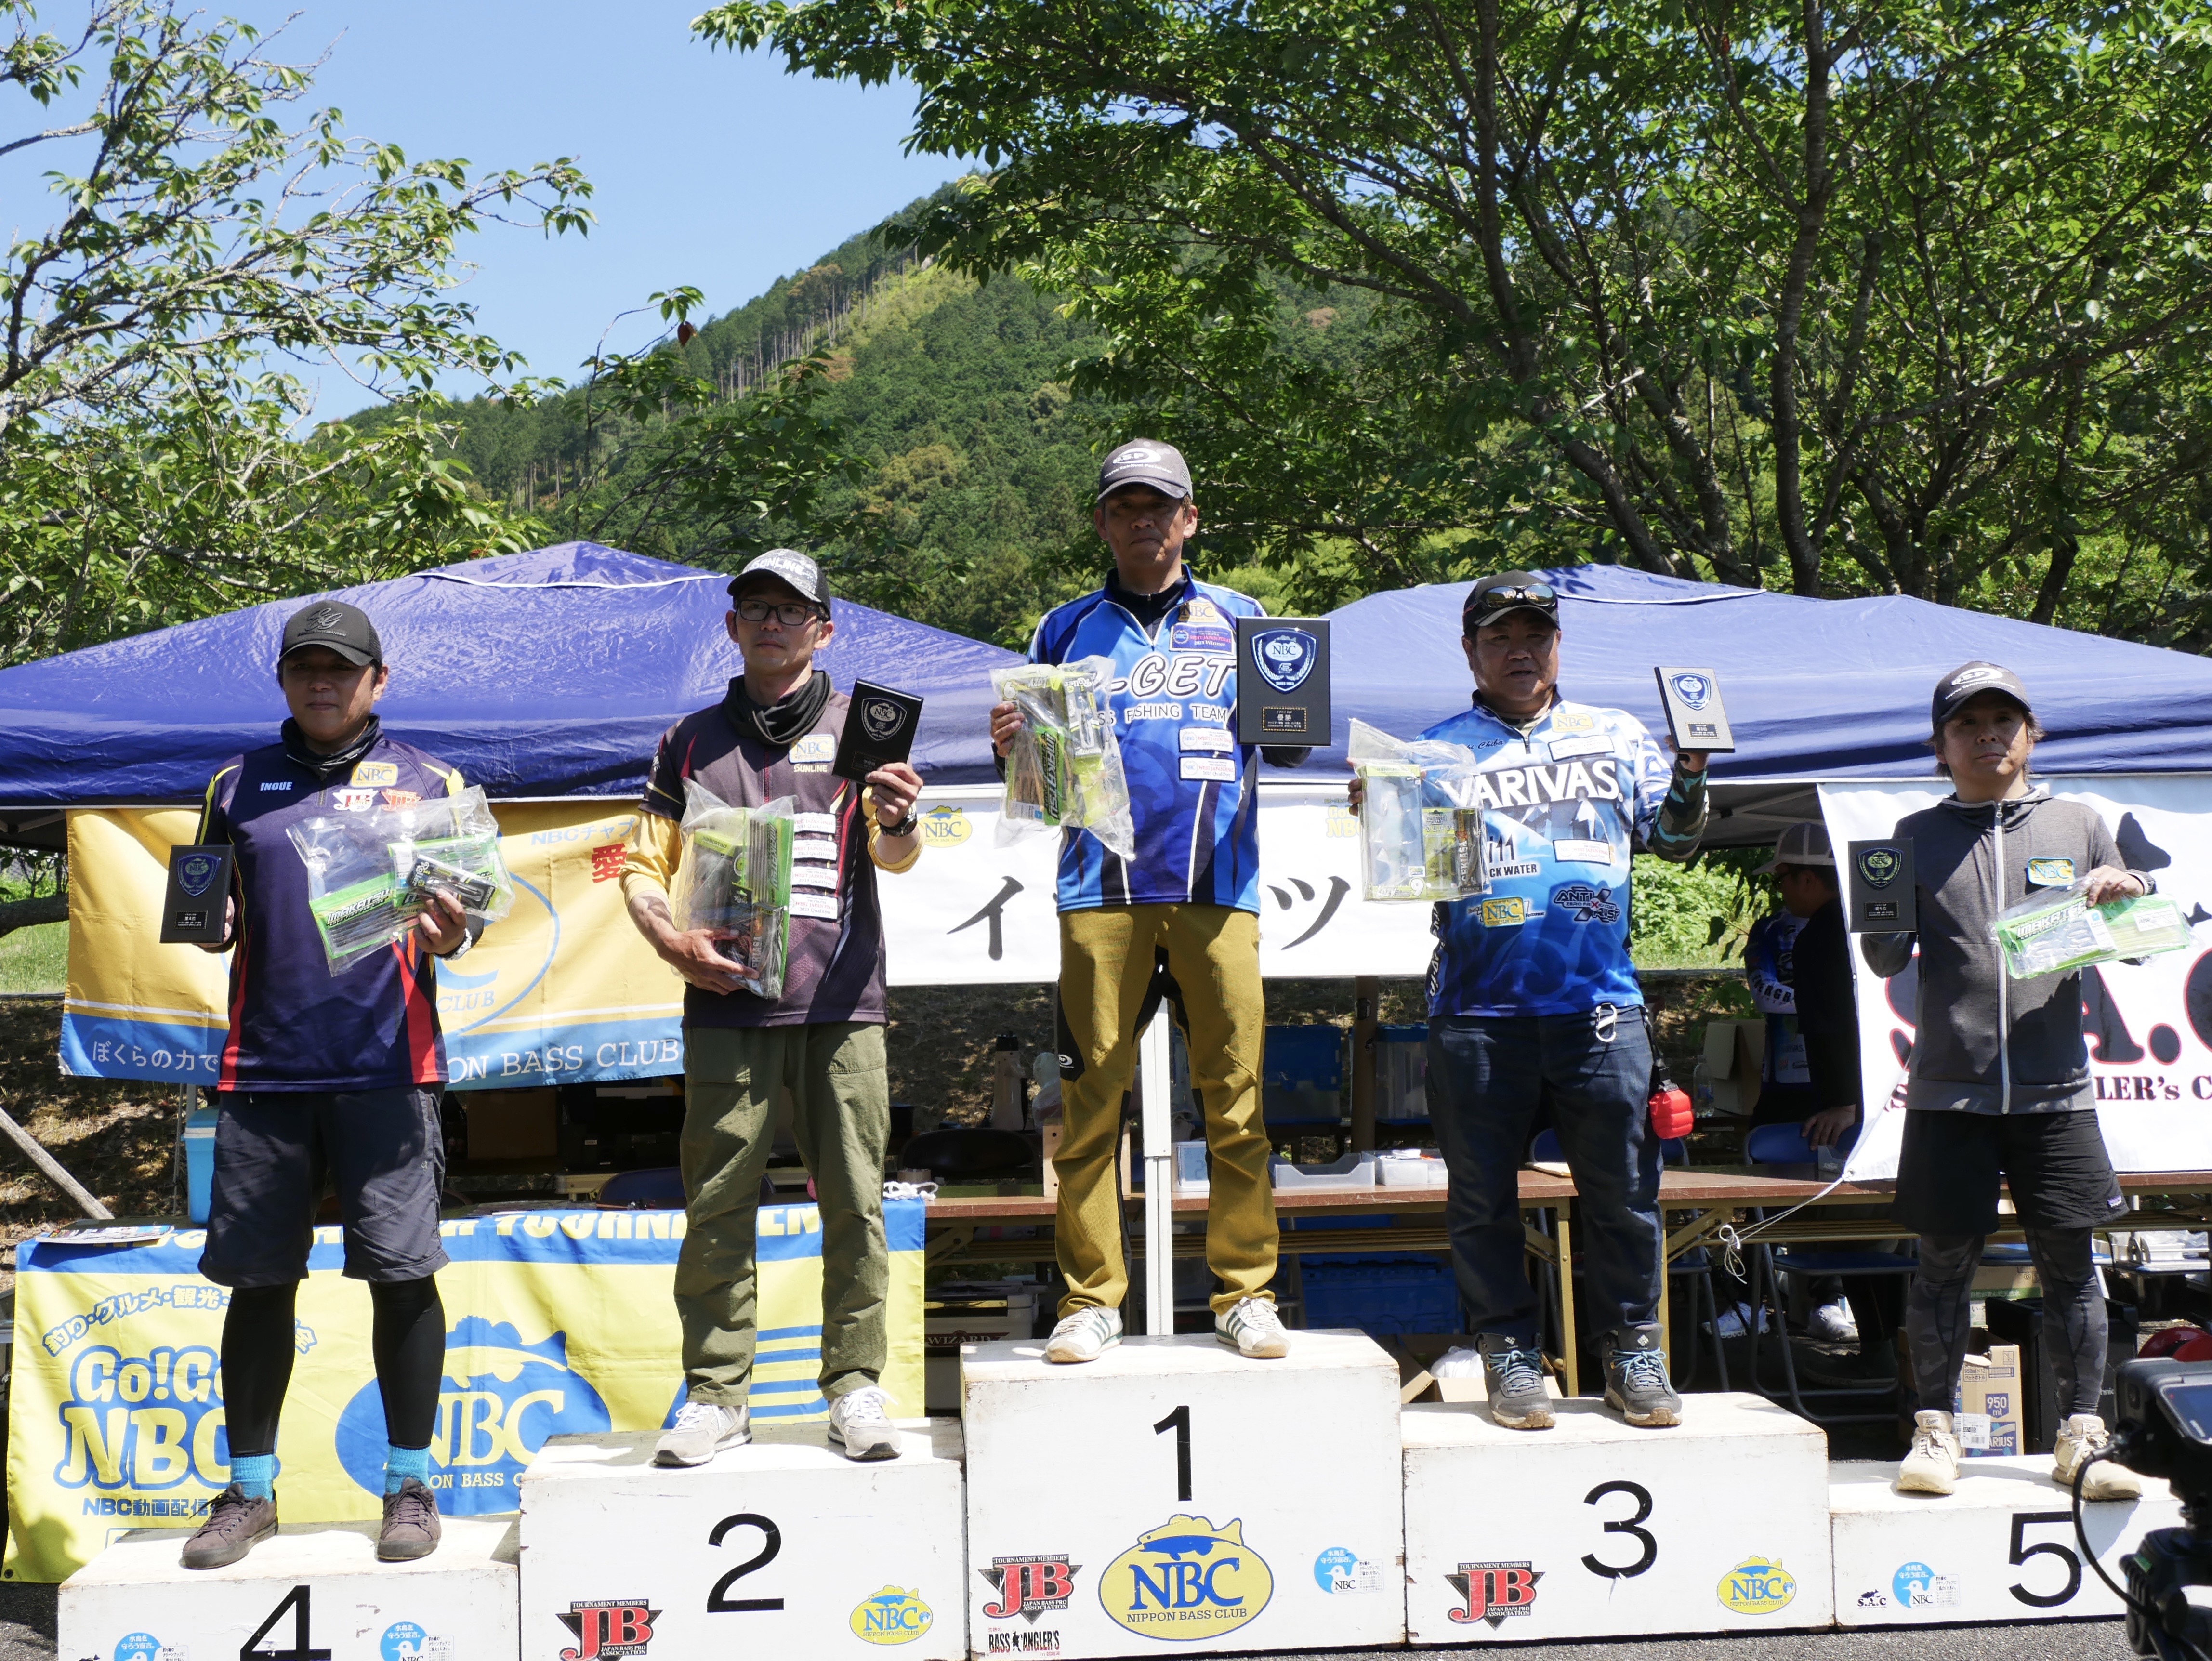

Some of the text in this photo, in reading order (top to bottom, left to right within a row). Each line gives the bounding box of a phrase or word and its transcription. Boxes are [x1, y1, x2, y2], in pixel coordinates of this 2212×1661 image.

[1181, 606, 1215, 618] NBC
[1272, 645, 1297, 656] NBC
[874, 708, 892, 719] NBC
[1126, 704, 1228, 723] FISHING TEAM
[1556, 716, 1590, 728] NBC
[795, 739, 830, 755] NBC
[1477, 738, 1505, 750] Chiba
[356, 766, 393, 782] NBC
[793, 764, 828, 773] SUNLINE
[1045, 731, 1060, 820] IMAKATSU
[260, 781, 293, 791] INOUE
[1437, 760, 1620, 810] VARIVAS
[923, 821, 962, 838] NBC
[591, 843, 628, 883] 愛
[1504, 863, 1538, 877] WATER
[2034, 864, 2069, 880] NBC
[811, 878, 832, 886] Qualifyer
[327, 888, 391, 926] IMAKATSU
[811, 907, 831, 915] Qualifyer
[1486, 903, 1520, 920] NBC
[752, 936, 763, 969] EKIASA
[437, 990, 495, 1013] CLUB
[92, 1041, 218, 1073] ぼくらの力で
[500, 1045, 583, 1077] BASS
[596, 1038, 680, 1068] CLUB
[927, 1335, 991, 1345] WIZARD
[70, 1345, 223, 1405] Go!G
[1987, 1396, 2007, 1409] 950
[1153, 1405, 1192, 1502] 1
[461, 1472, 504, 1489] BASS
[81, 1497, 215, 1517] NBC動画配信
[1580, 1480, 1658, 1579] 3
[706, 1512, 784, 1613] 2
[2008, 1511, 2082, 1608] 5
[985, 1562, 1073, 1617] JB
[1128, 1557, 1244, 1610] NBC
[1334, 1580, 1356, 1590] NBC
[1729, 1577, 1783, 1601] NBC
[1450, 1569, 1535, 1621] JB
[1857, 1597, 1887, 1607] S.A.C
[1912, 1594, 1933, 1605] NBC
[239, 1584, 332, 1661] 4
[863, 1607, 919, 1631] NBC
[1126, 1608, 1247, 1623] NIPPON BASS CLUB
[562, 1607, 652, 1661] JB
[988, 1630, 1060, 1654] BASS ANGLER'S
